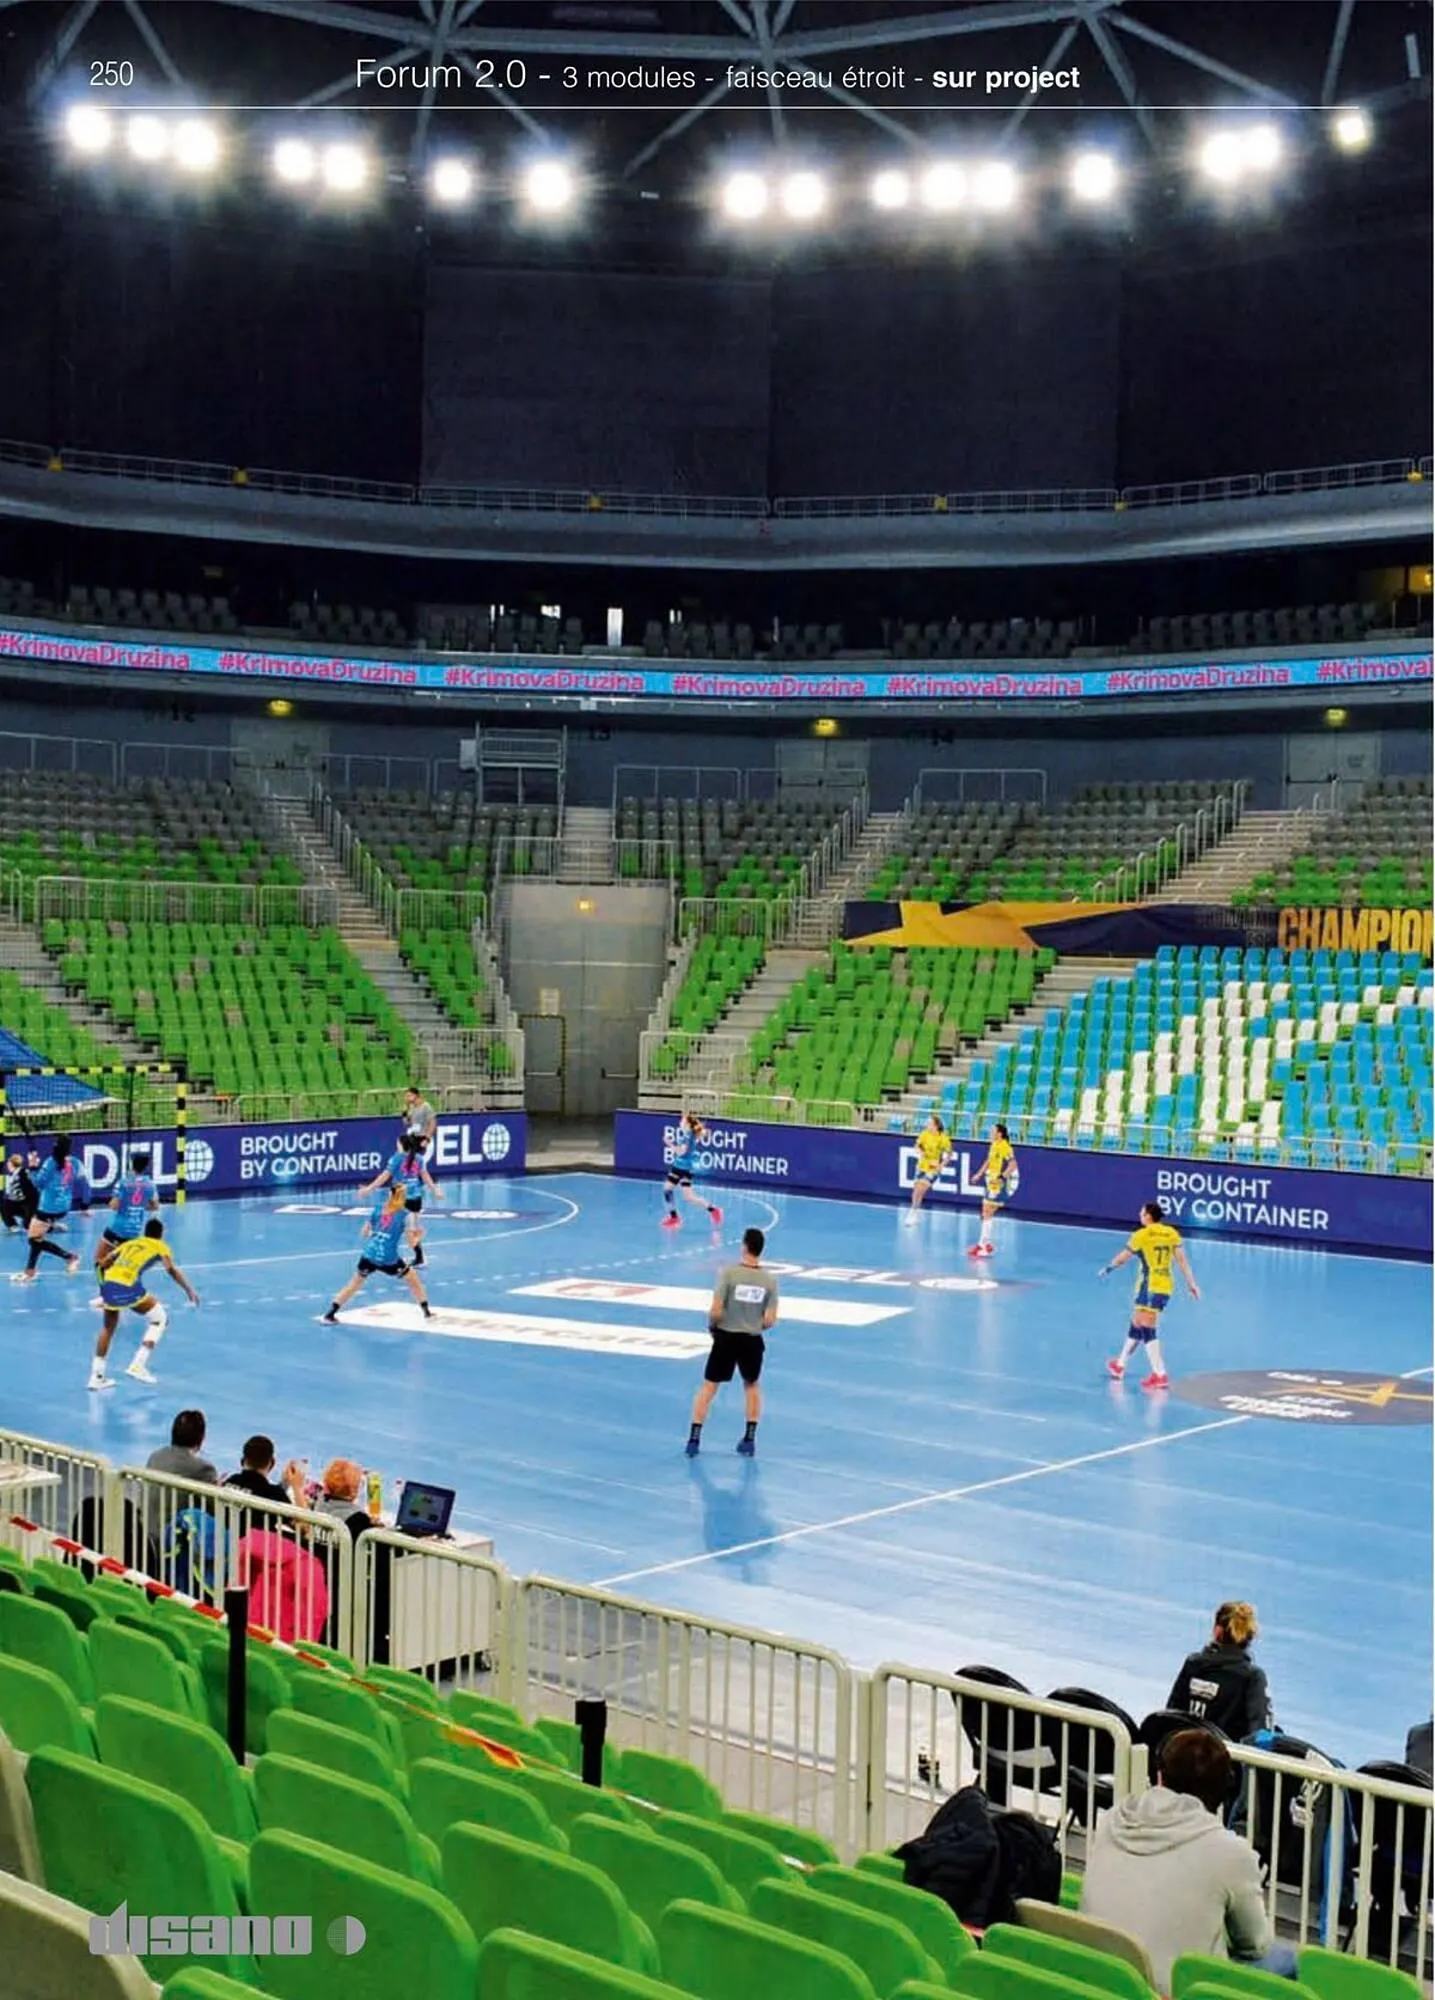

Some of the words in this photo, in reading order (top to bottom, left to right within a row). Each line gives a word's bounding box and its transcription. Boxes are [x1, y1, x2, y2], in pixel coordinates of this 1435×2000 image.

[1316, 655, 1434, 681] #Krimova
[241, 1131, 338, 1156] BROUGHT
[663, 1125, 748, 1151] BRUGHT
[241, 1158, 267, 1179] BY
[271, 1152, 382, 1176] CONTAINER
[1156, 1170, 1272, 1199] BROUGHT
[1156, 1195, 1186, 1217] BY
[1191, 1199, 1330, 1230] CONTAINER
